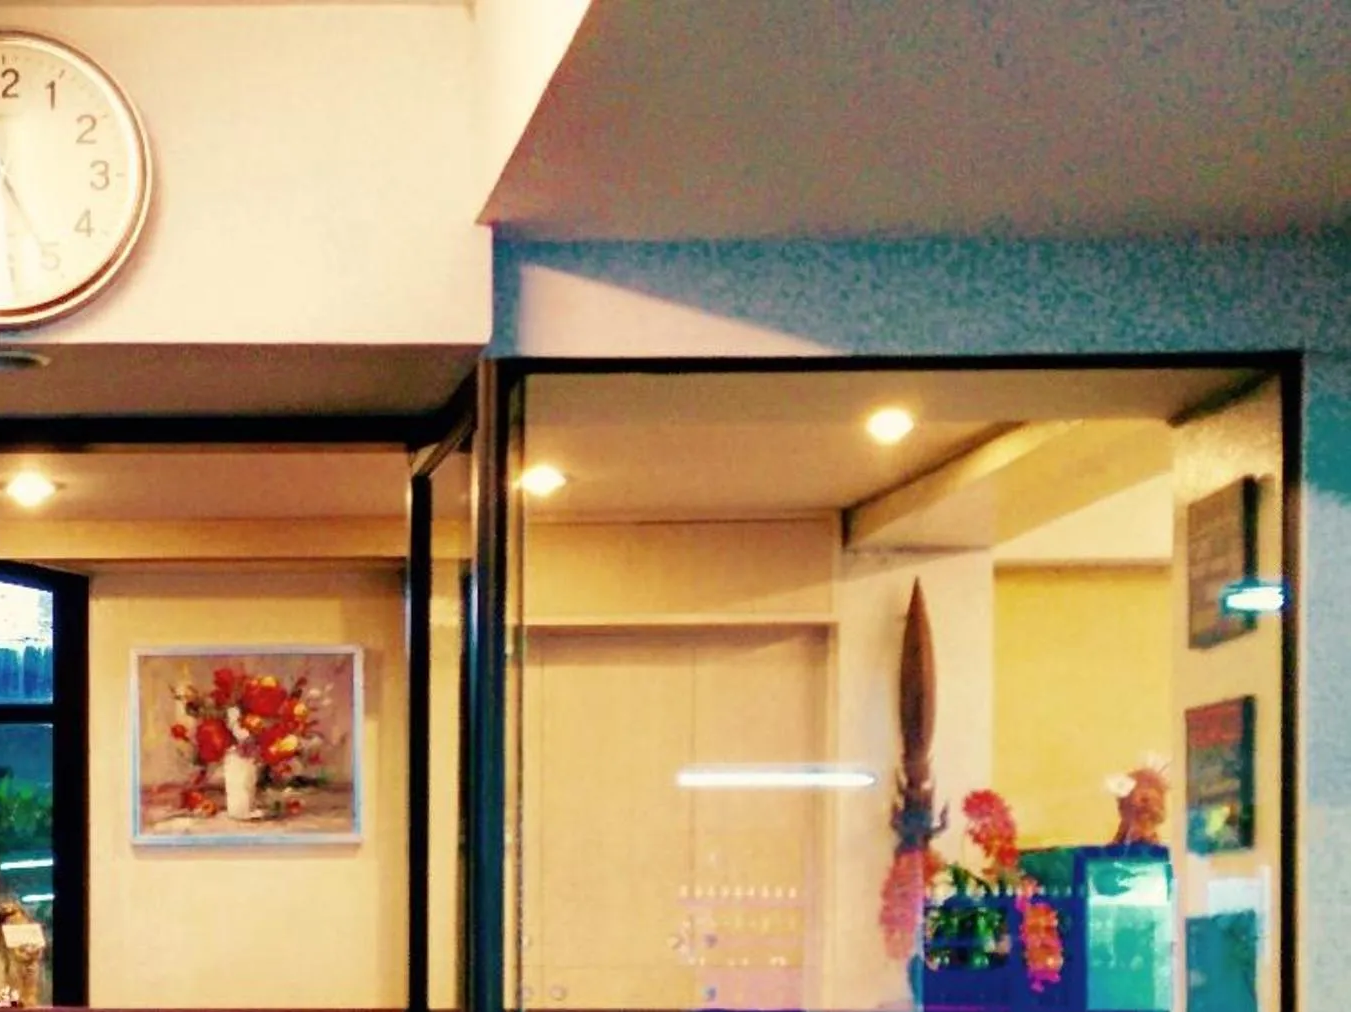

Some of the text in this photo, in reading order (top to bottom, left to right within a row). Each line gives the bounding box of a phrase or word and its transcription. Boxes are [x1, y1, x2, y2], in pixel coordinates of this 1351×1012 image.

[45, 81, 56, 111] 1
[76, 114, 98, 145] 2
[90, 160, 110, 191] 3
[74, 209, 95, 238] 4
